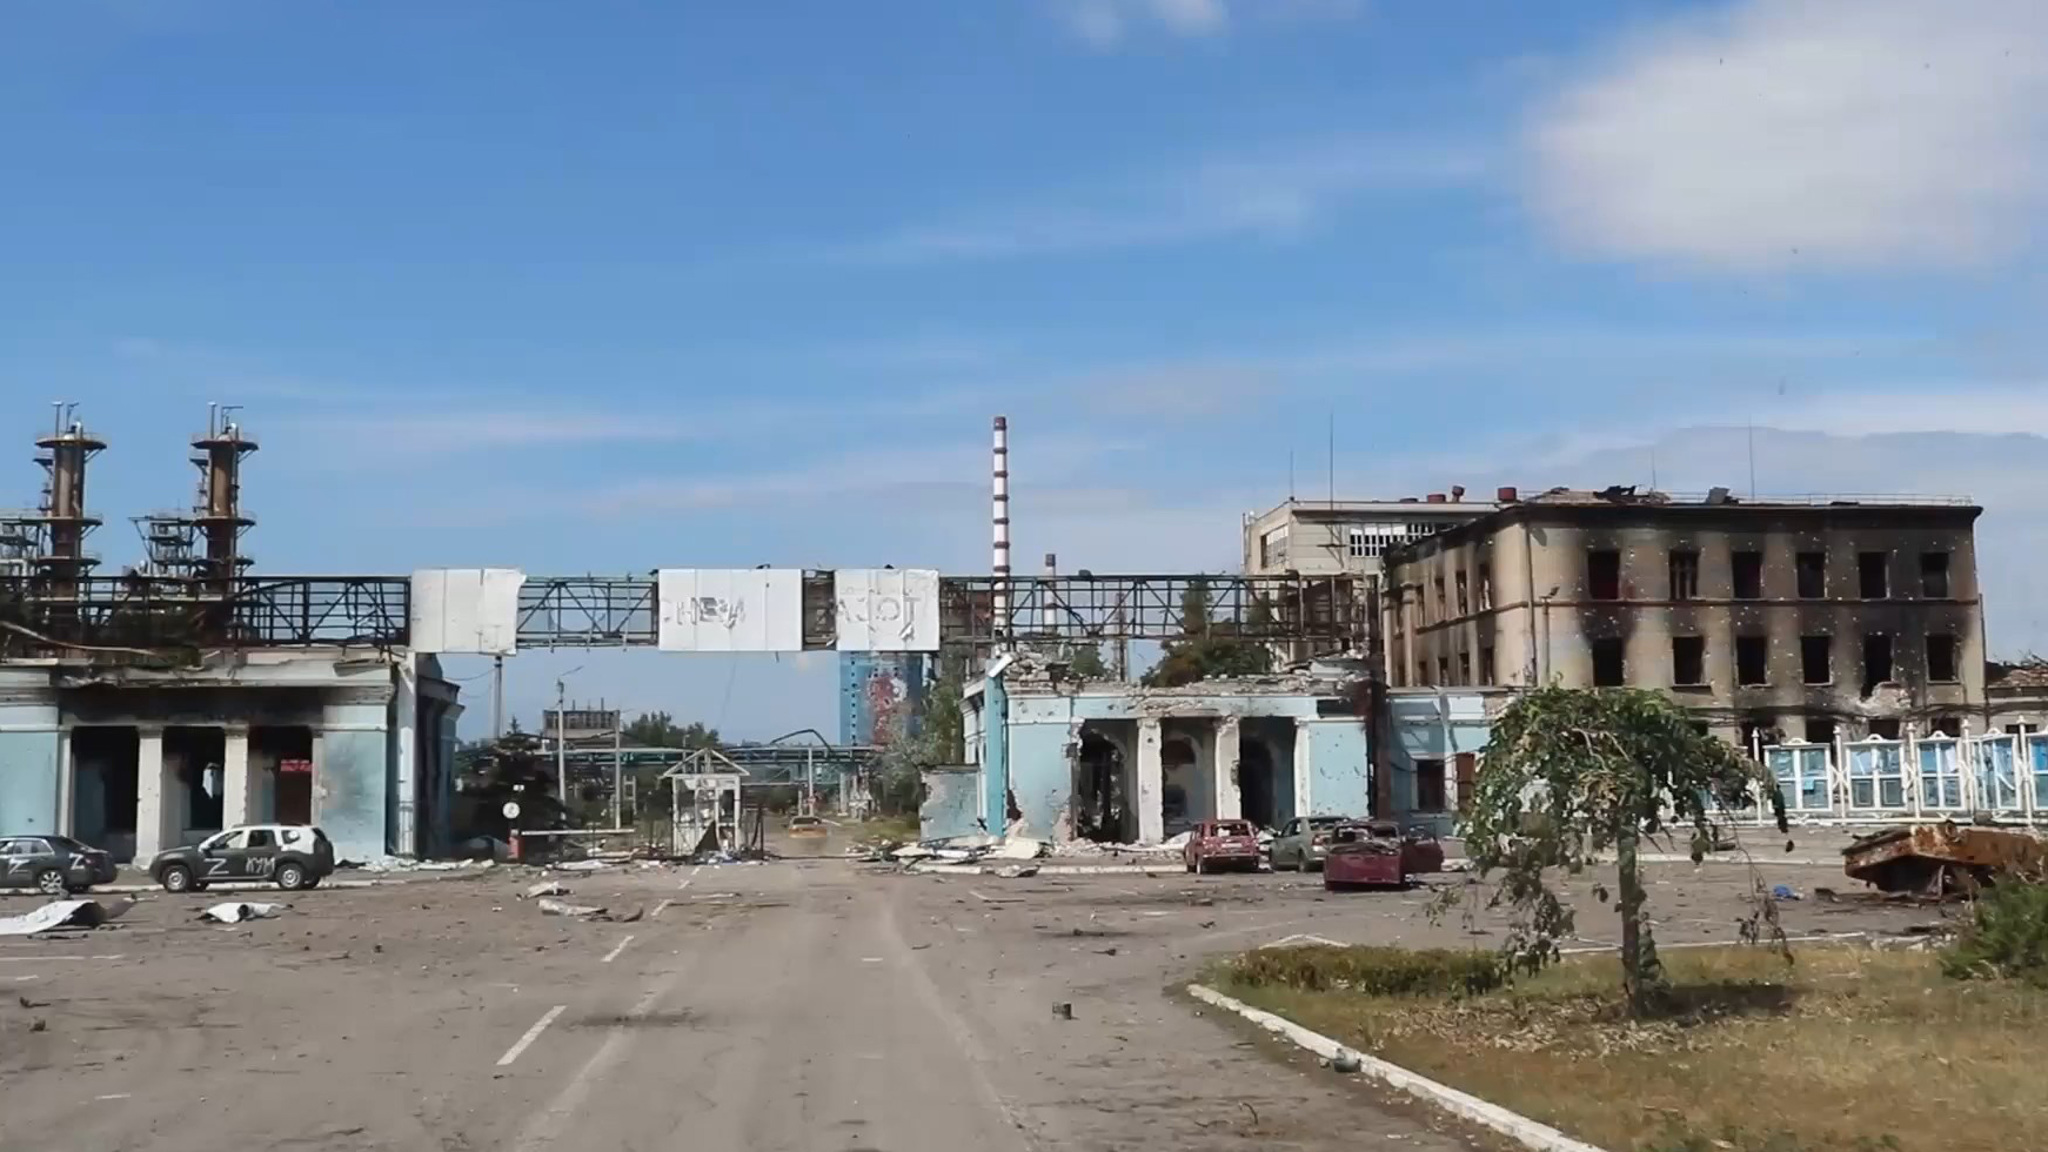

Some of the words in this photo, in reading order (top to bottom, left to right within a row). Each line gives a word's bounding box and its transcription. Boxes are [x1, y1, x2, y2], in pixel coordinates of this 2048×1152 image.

[8, 858, 31, 875] Z
[68, 852, 85, 870] Z
[204, 858, 229, 875] Z
